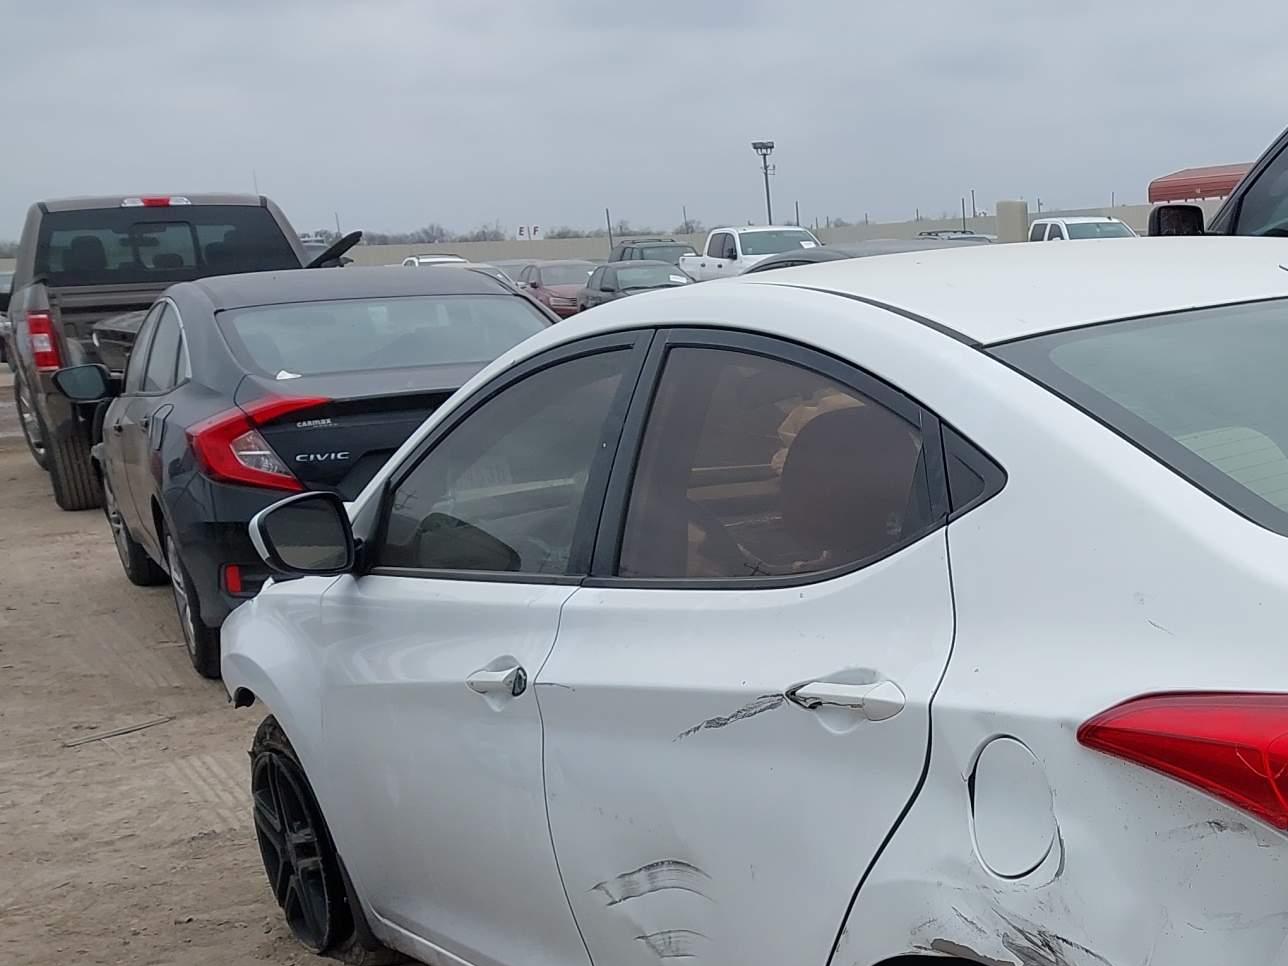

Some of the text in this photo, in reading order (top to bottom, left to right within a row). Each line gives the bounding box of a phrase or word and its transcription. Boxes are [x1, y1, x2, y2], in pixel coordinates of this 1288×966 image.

[518, 225, 540, 236] E F
[295, 451, 350, 462] CIVIC
